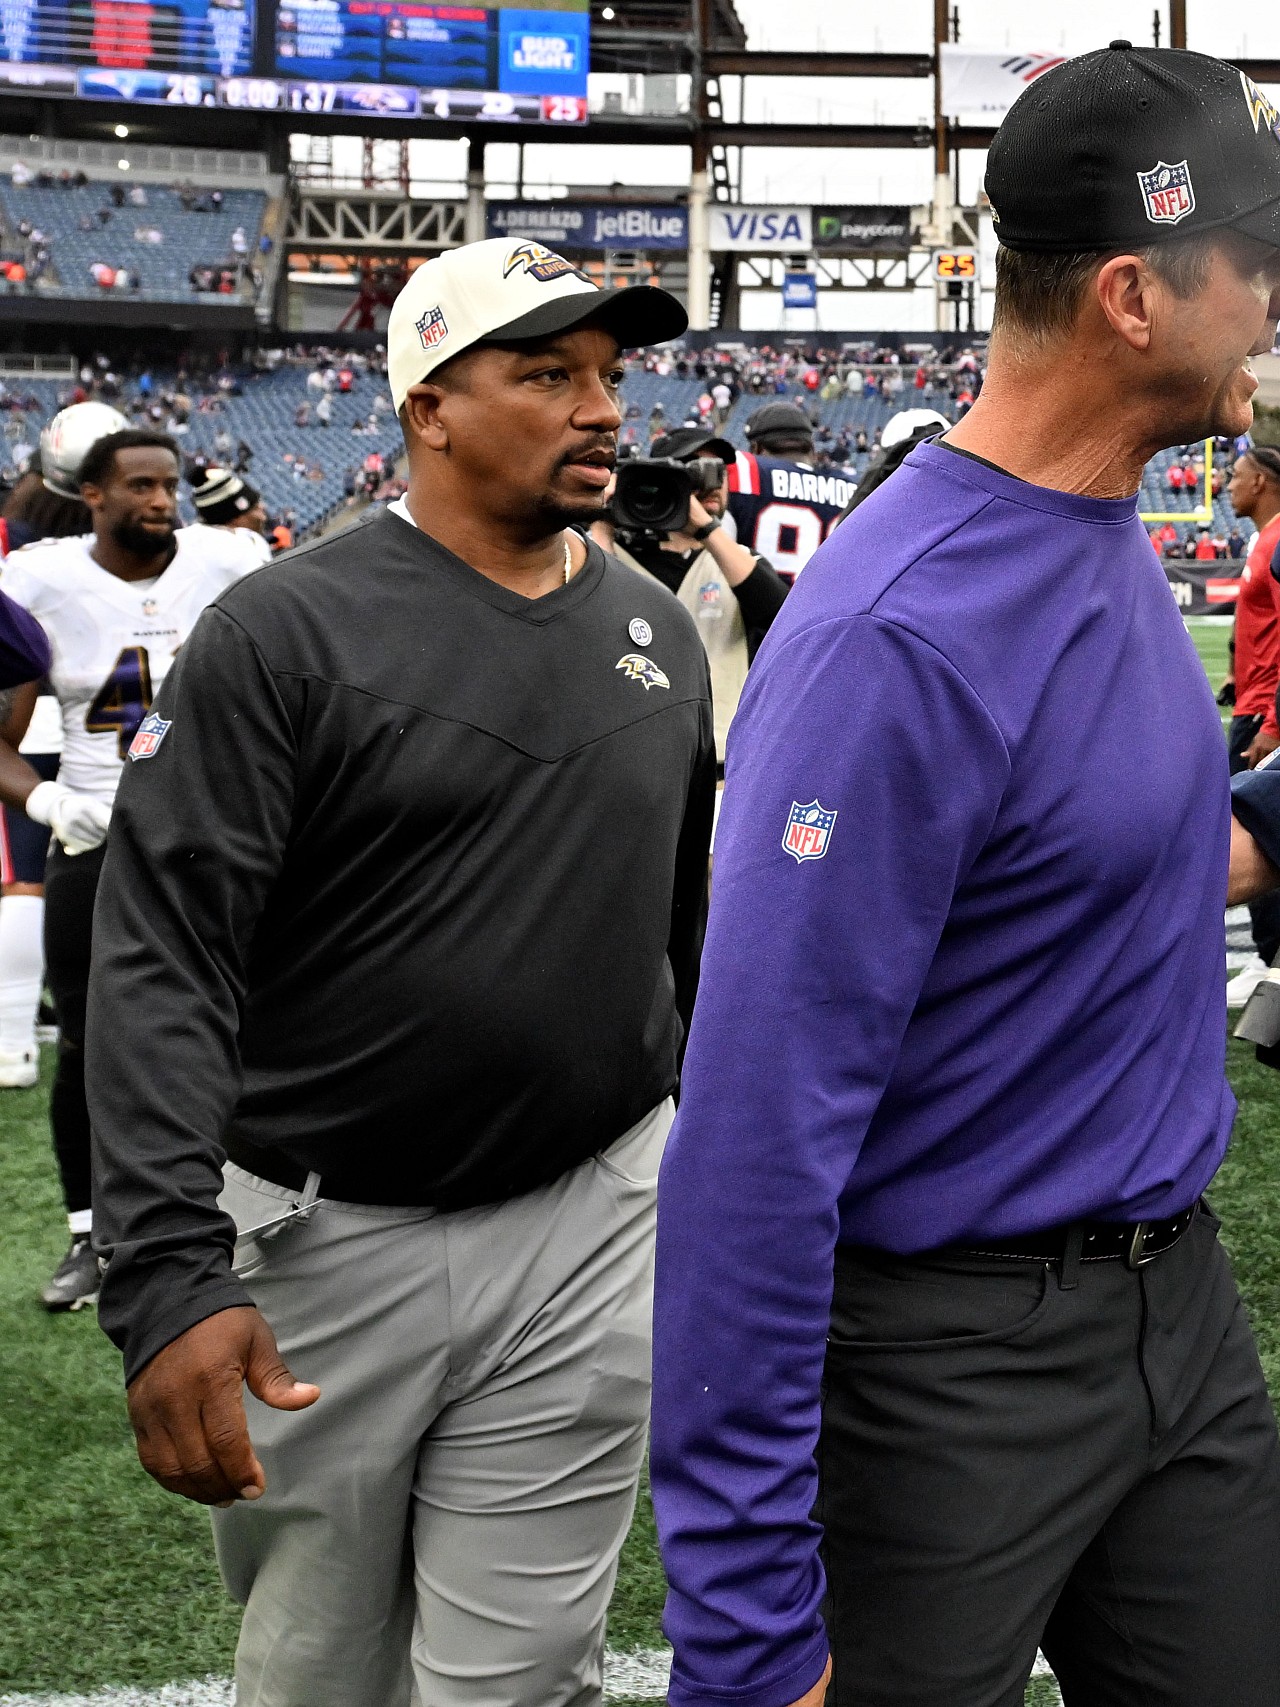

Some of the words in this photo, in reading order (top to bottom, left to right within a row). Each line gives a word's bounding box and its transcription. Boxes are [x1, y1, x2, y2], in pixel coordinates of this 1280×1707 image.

[521, 36, 569, 51] BUD
[513, 50, 575, 70] LIGHT
[1150, 186, 1189, 218] NFL
[594, 210, 684, 242] jetBlue
[724, 213, 803, 240] VISA
[841, 224, 905, 240] paycom
[937, 255, 975, 276] 25
[422, 322, 446, 347] NFL
[753, 501, 842, 588] 9
[85, 645, 153, 762] 4
[787, 823, 823, 854] NFL
